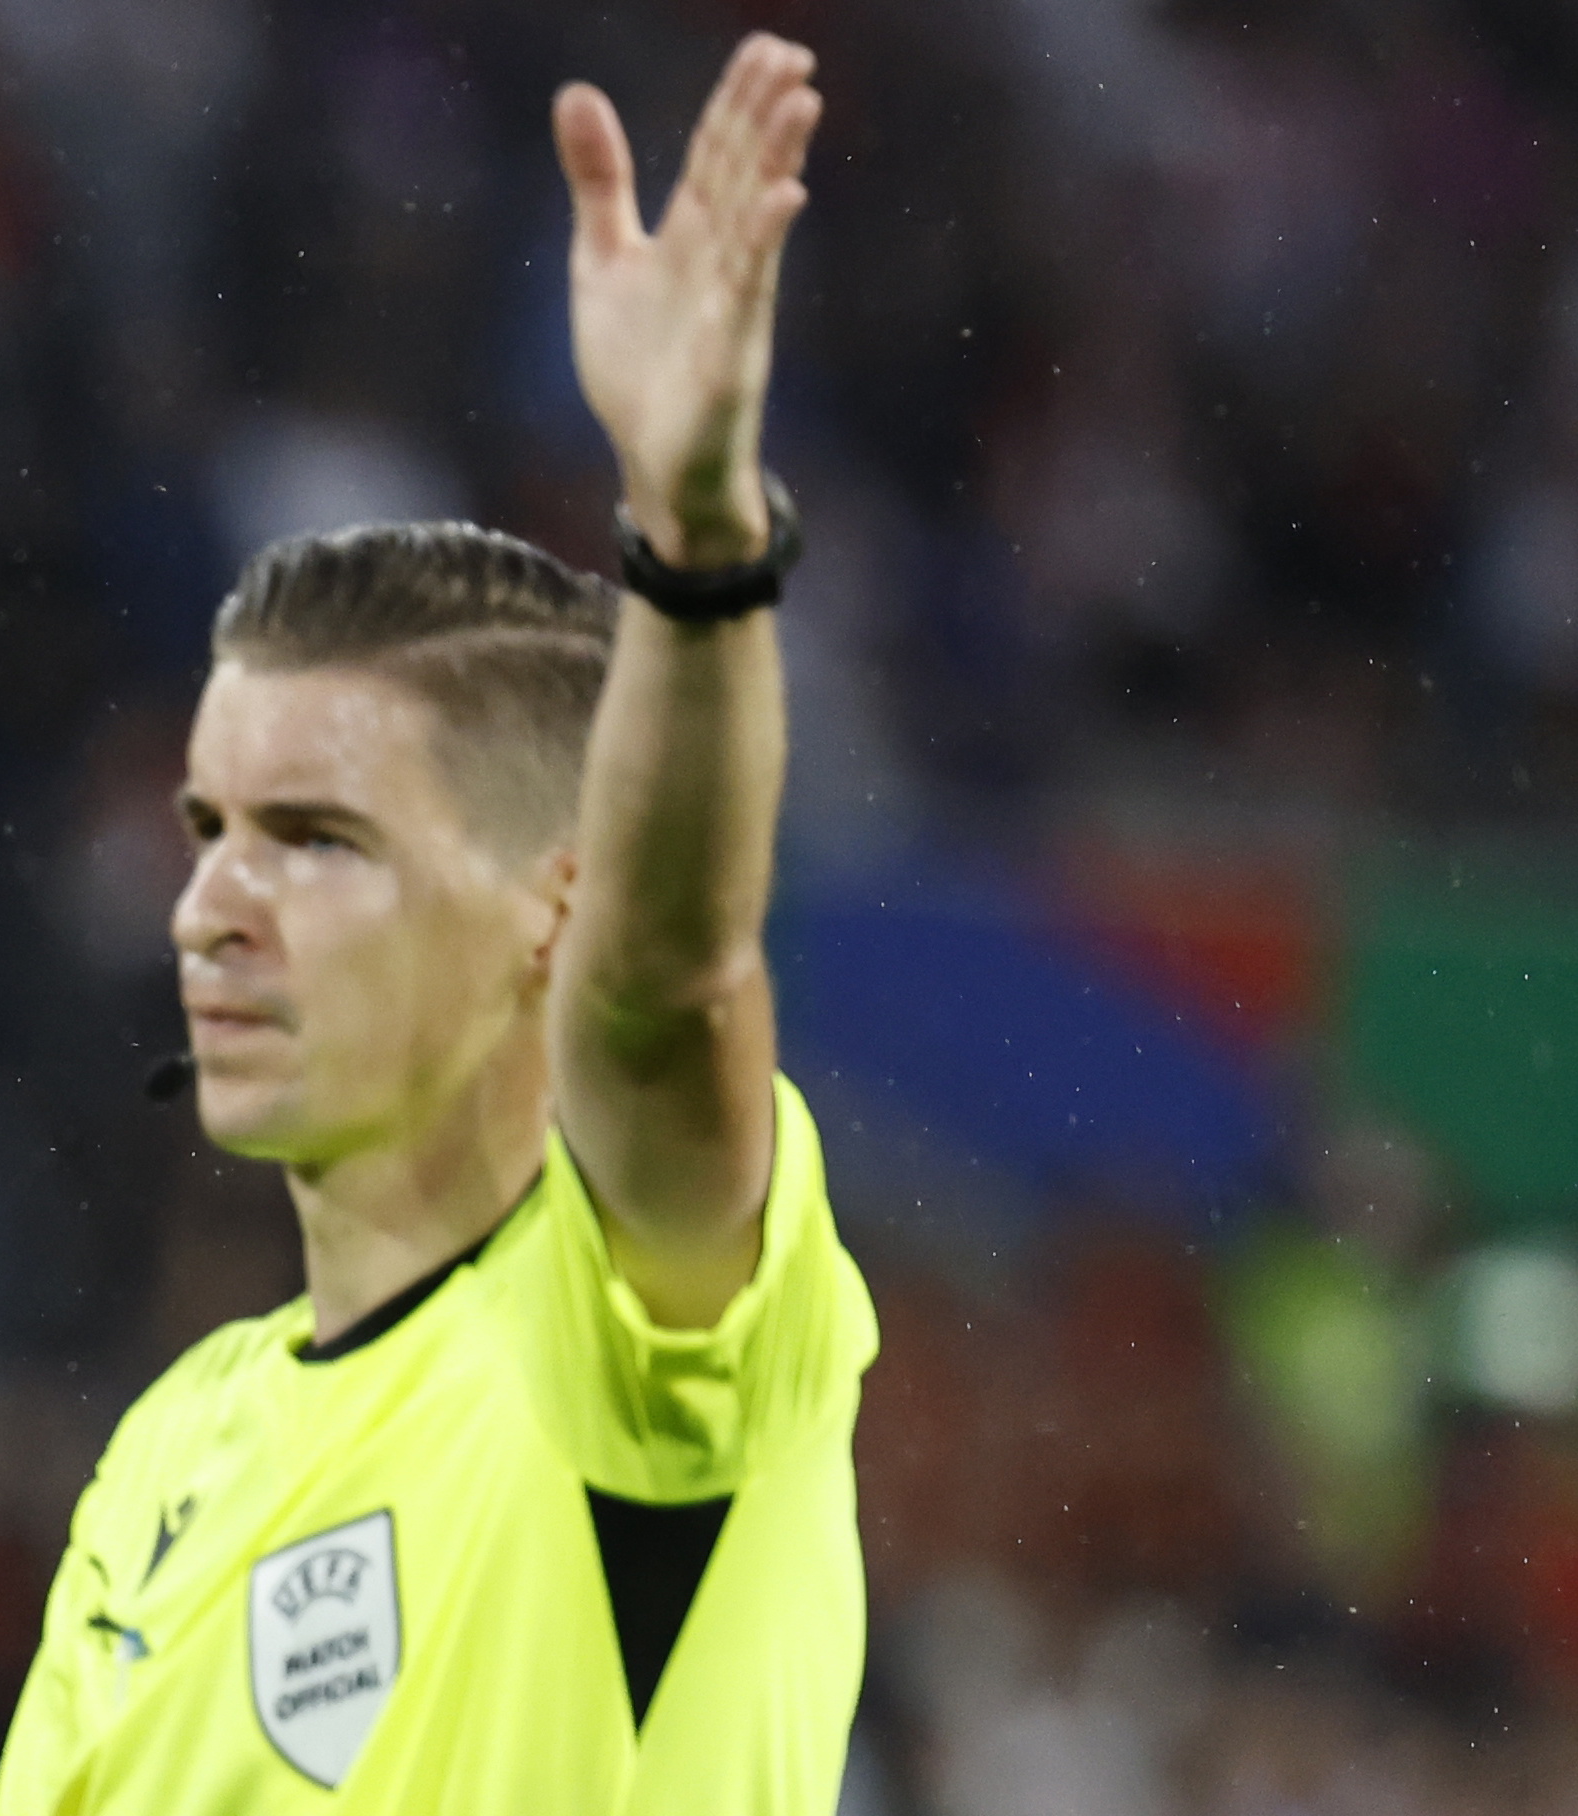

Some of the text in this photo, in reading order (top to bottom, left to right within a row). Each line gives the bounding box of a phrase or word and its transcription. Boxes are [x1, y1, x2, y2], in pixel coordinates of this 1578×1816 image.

[272, 1548, 370, 1619] UEFA
[285, 1628, 368, 1676] MATCH
[274, 1663, 380, 1721] OFFICIAL
